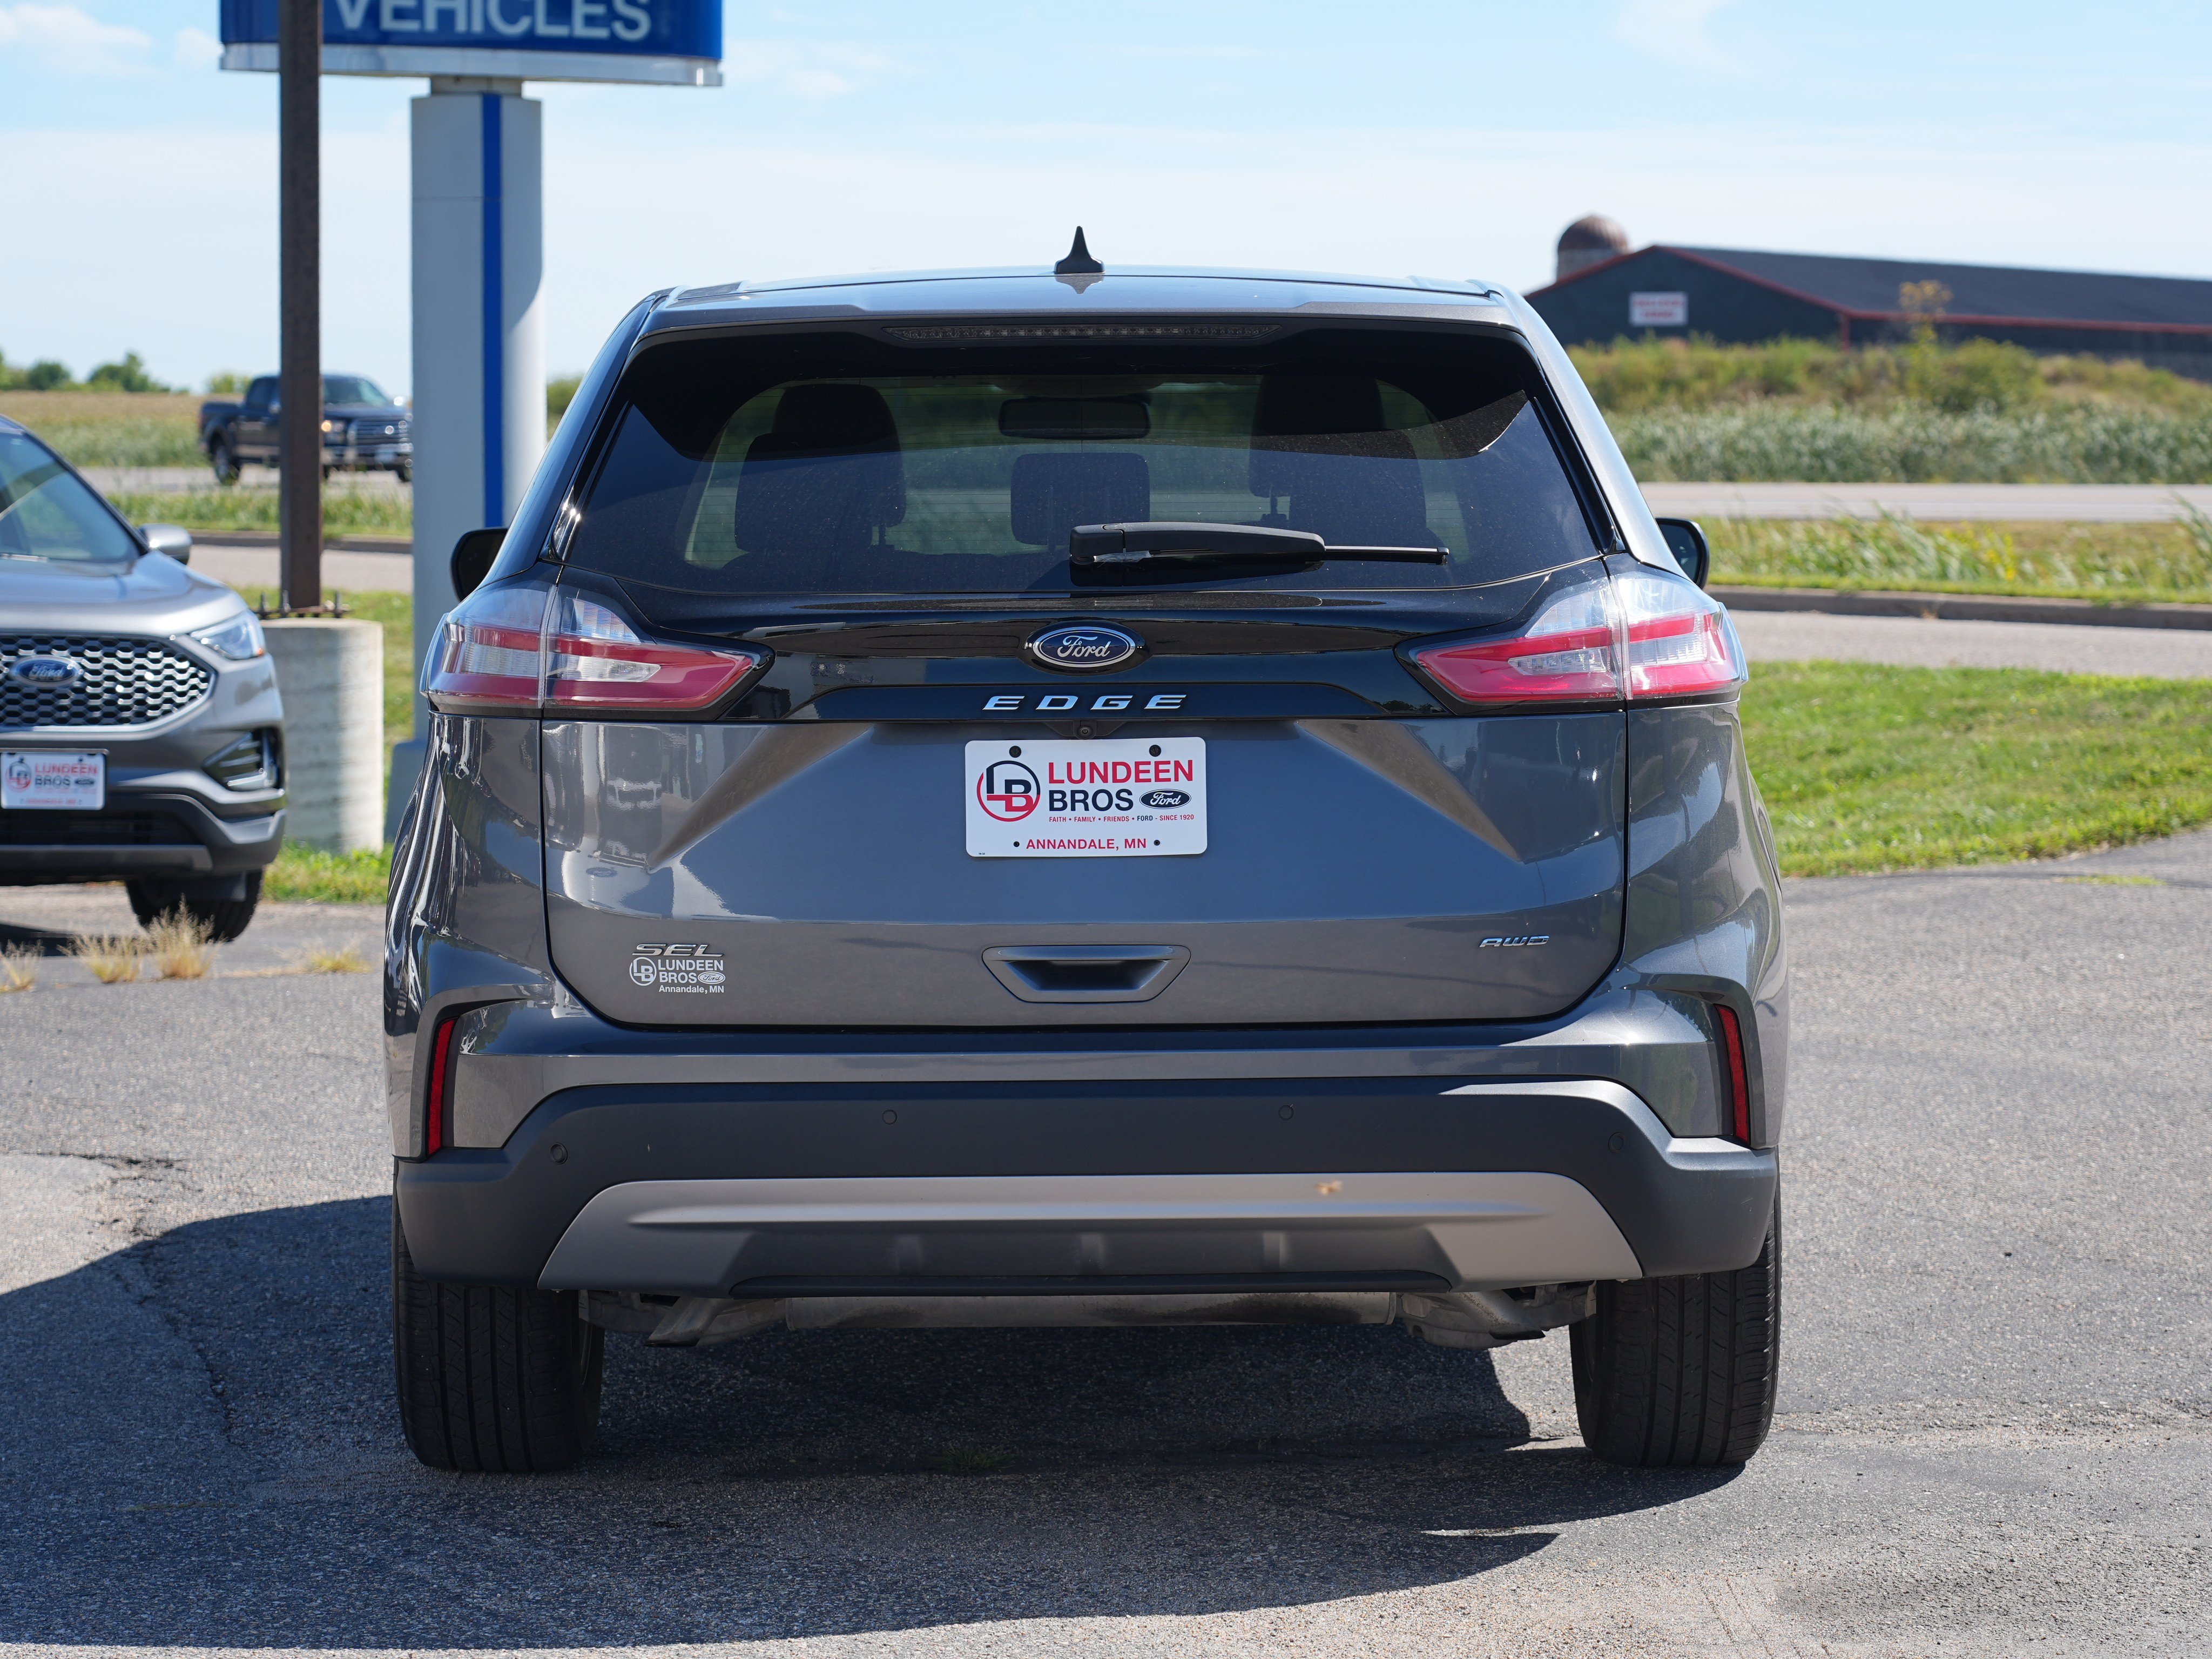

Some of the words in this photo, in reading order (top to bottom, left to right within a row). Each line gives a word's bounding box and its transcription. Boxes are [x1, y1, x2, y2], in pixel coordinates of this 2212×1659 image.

[335, 0, 651, 42] VEHICLES
[1057, 635, 1111, 657] Ford
[982, 694, 1187, 711] EDGE
[1048, 760, 1193, 784] LUNDEEN
[1049, 788, 1134, 812] BROS
[1150, 792, 1181, 806] Ford
[1026, 838, 1120, 851] ANNANDALE,
[1124, 838, 1147, 849] MN
[1479, 935, 1549, 948] AWD
[632, 943, 724, 957] SEL
[658, 959, 724, 971] LUNDEEN
[659, 972, 697, 983] BROS
[659, 985, 708, 994] Annandale,
